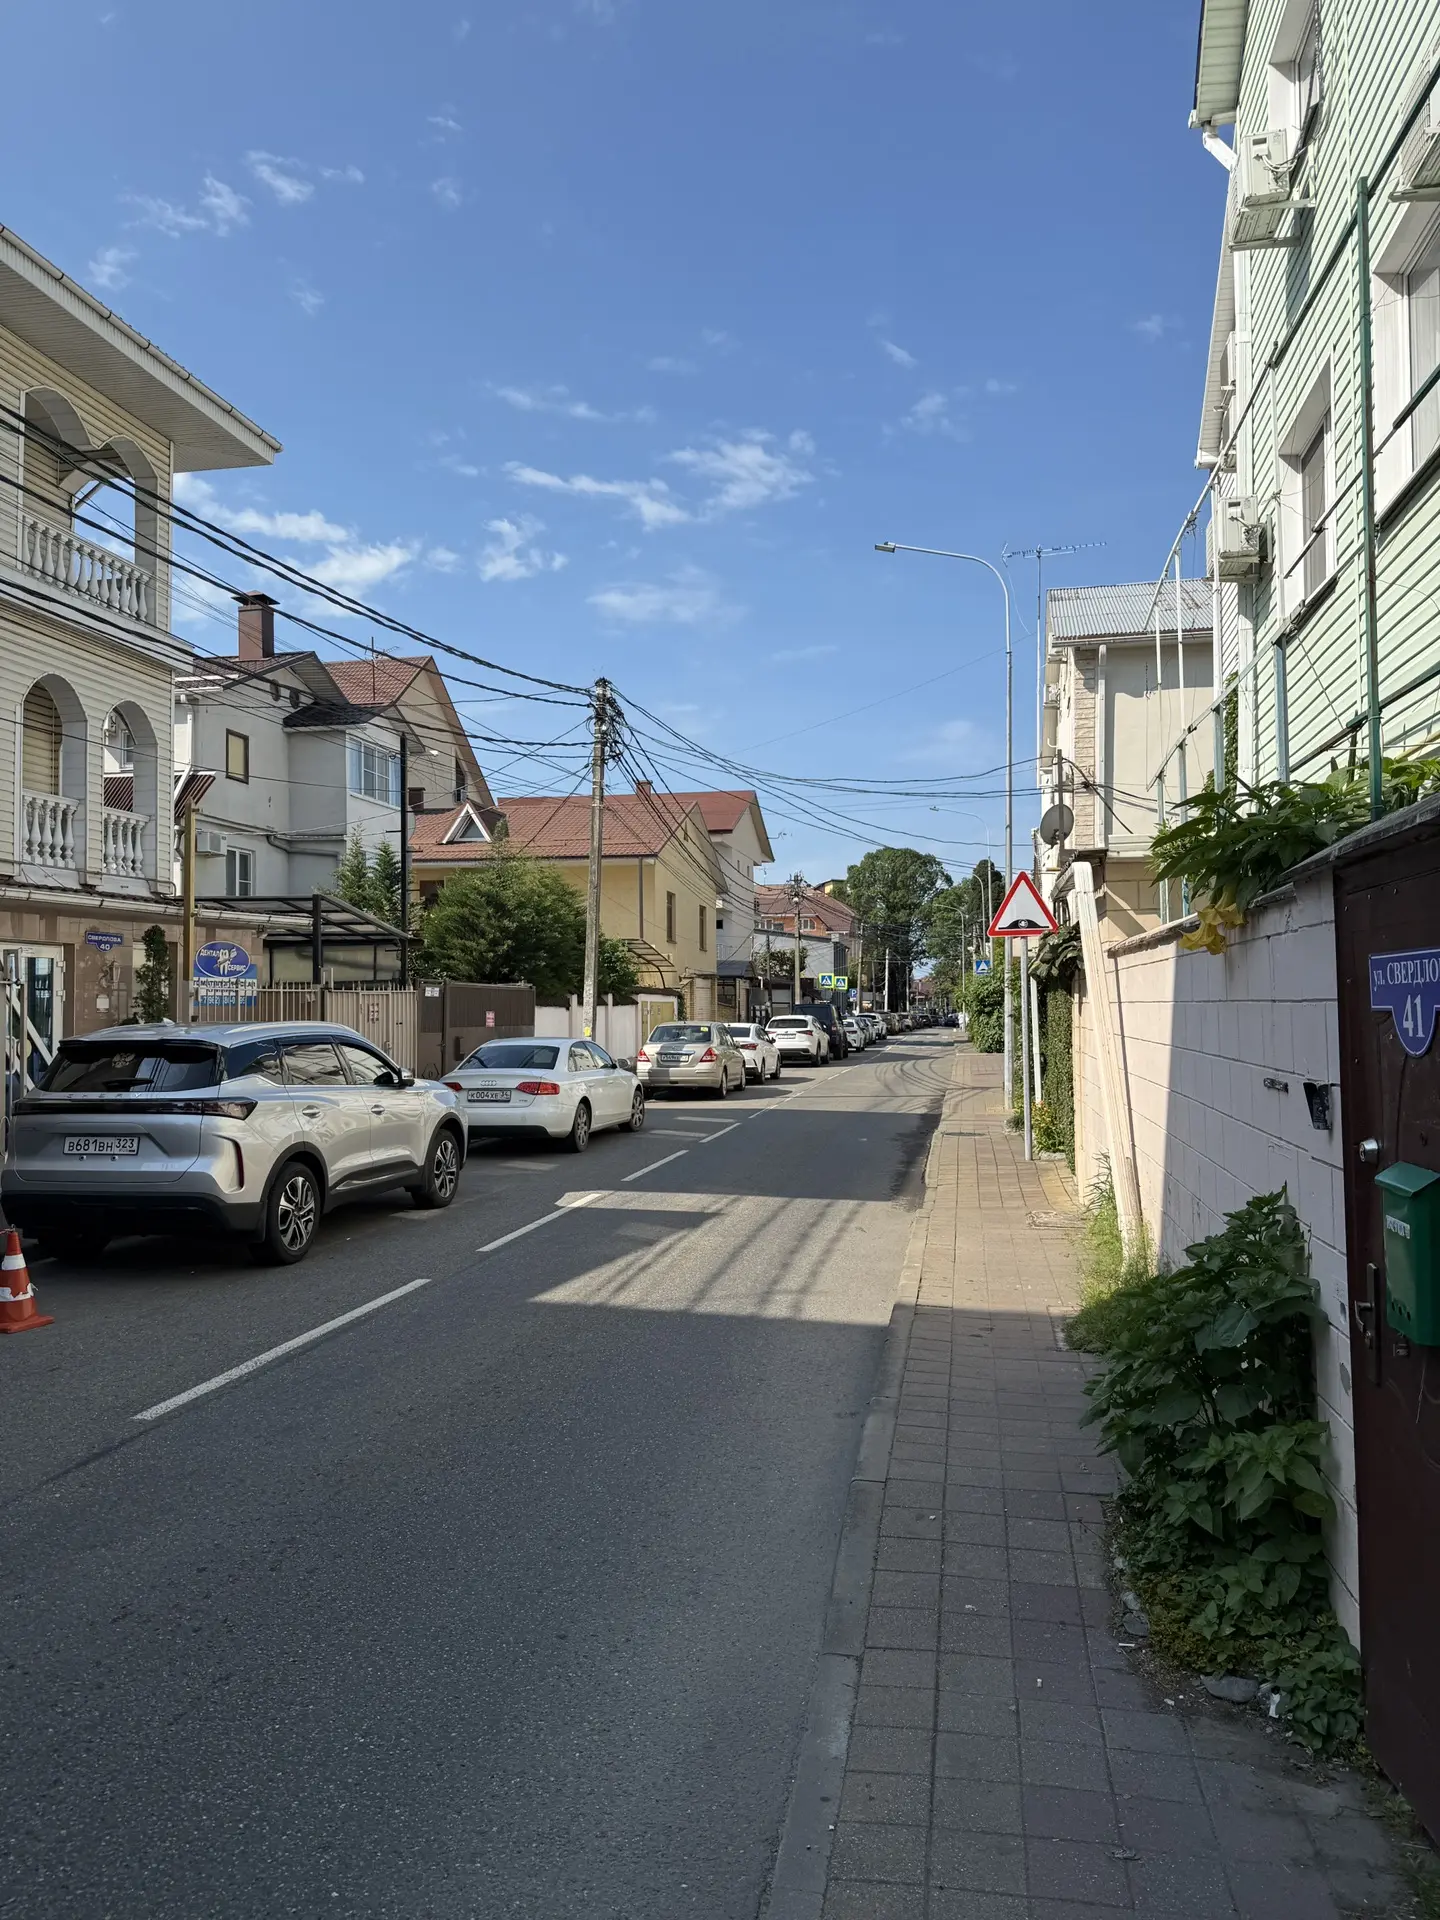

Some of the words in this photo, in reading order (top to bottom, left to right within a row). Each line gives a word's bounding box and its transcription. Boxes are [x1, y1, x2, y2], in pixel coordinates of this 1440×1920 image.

[99, 943, 111, 951] 40
[227, 964, 247, 972] СЕРВИС
[1373, 970, 1385, 991] ул.
[1387, 957, 1440, 988] СВЕРДЛО
[1402, 994, 1425, 1038] 41
[115, 1138, 134, 1148] 323
